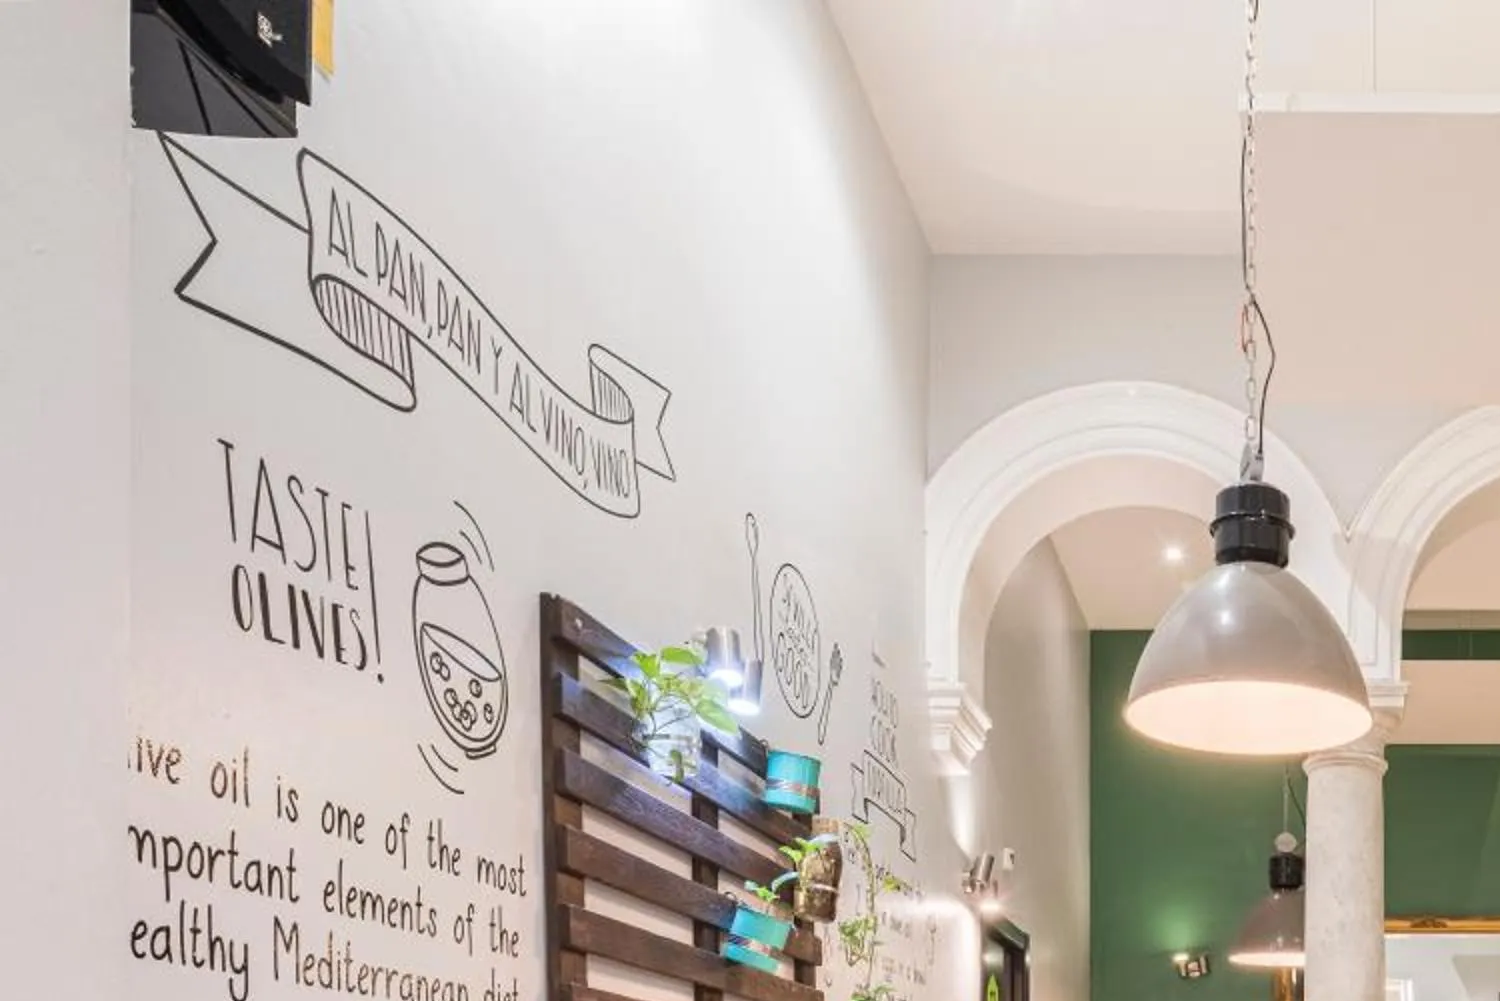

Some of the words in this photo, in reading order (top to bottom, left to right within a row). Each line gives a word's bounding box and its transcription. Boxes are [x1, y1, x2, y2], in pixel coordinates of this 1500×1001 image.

[327, 187, 368, 278] AL
[437, 279, 482, 375] PAN
[491, 336, 503, 395] Y
[509, 361, 537, 433] AL
[589, 434, 631, 499] VINO
[127, 735, 183, 784] ive
[210, 746, 251, 808] oil
[276, 775, 299, 823] is
[321, 801, 366, 845] one
[385, 812, 411, 869] of
[427, 818, 462, 877] the
[477, 854, 528, 897] most
[323, 858, 438, 939] elements
[453, 902, 477, 956] of
[488, 904, 521, 959] the
